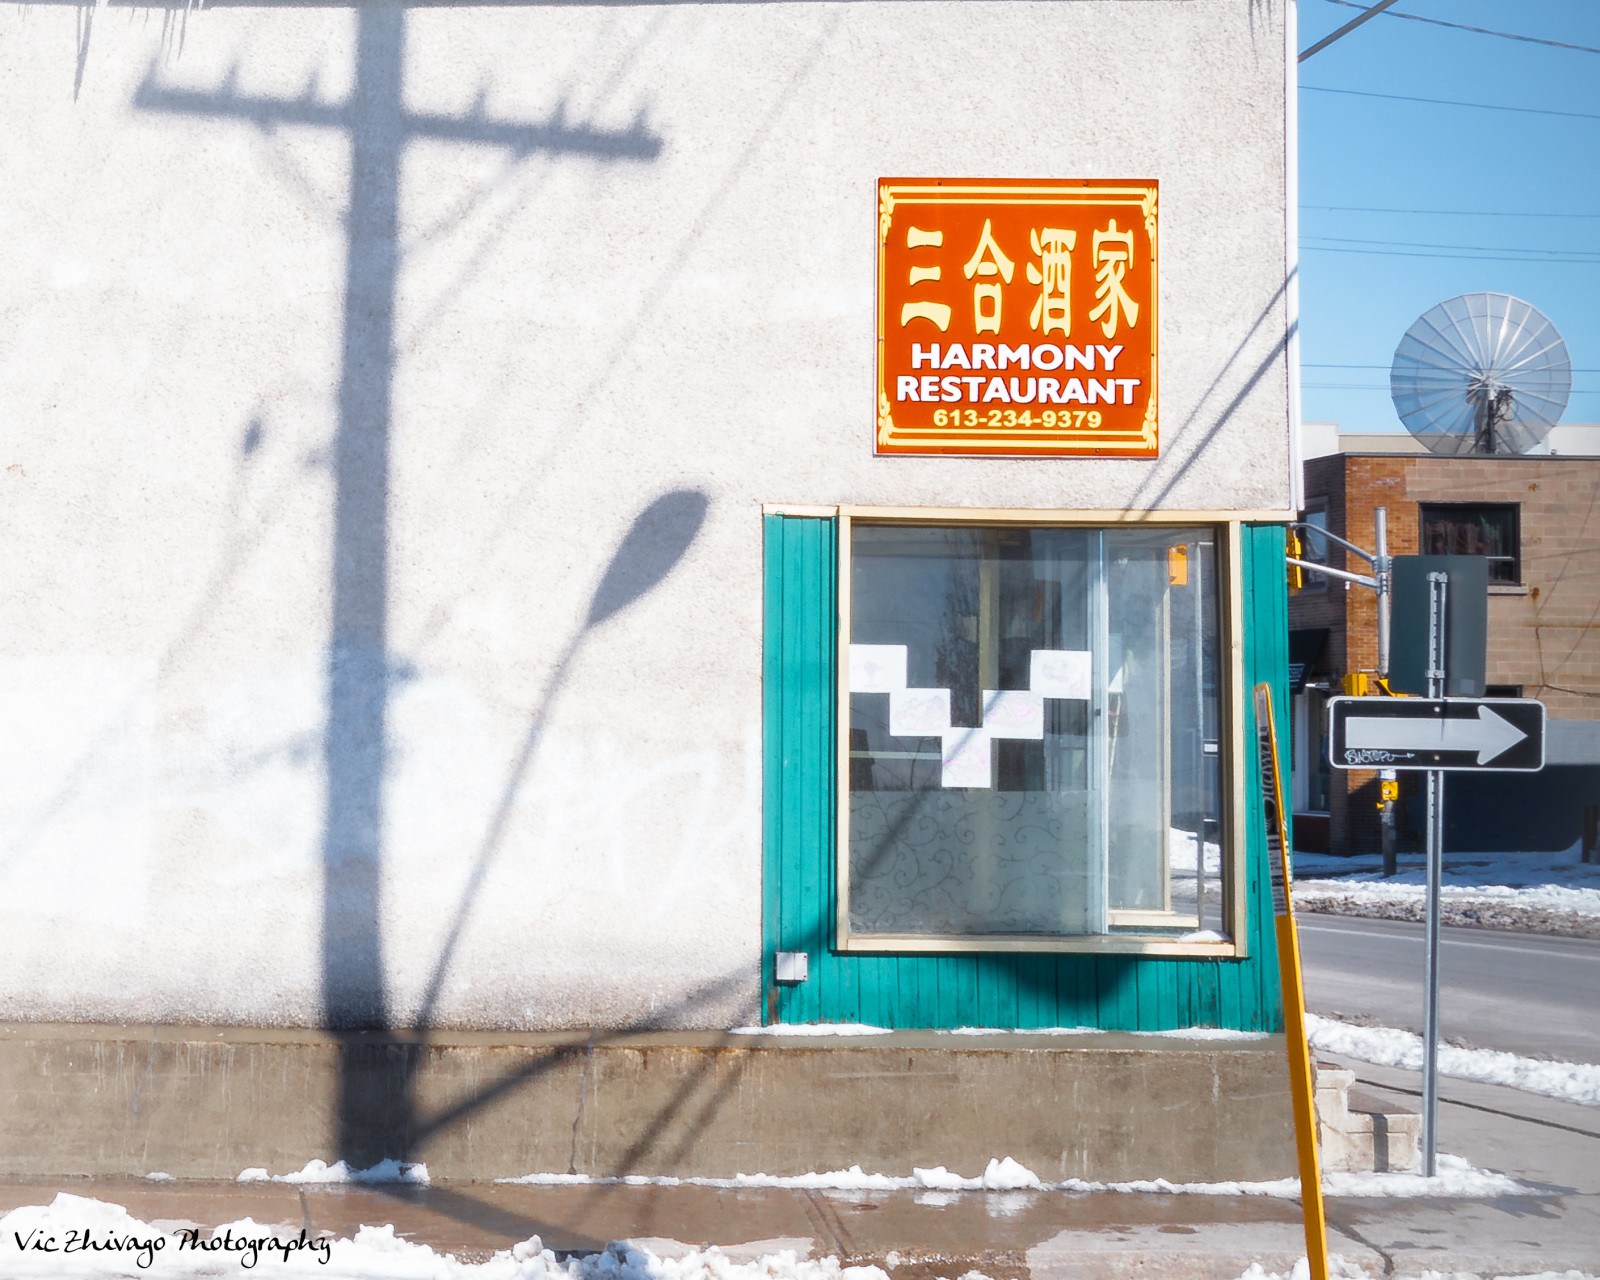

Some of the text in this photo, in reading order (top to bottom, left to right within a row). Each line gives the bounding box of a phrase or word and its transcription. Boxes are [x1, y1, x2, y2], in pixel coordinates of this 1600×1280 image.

[901, 218, 1139, 339] 三合酒家
[911, 343, 1124, 371] HARMONY
[896, 376, 1141, 405] RESTAURANT
[933, 409, 1102, 428] 613-234-9379
